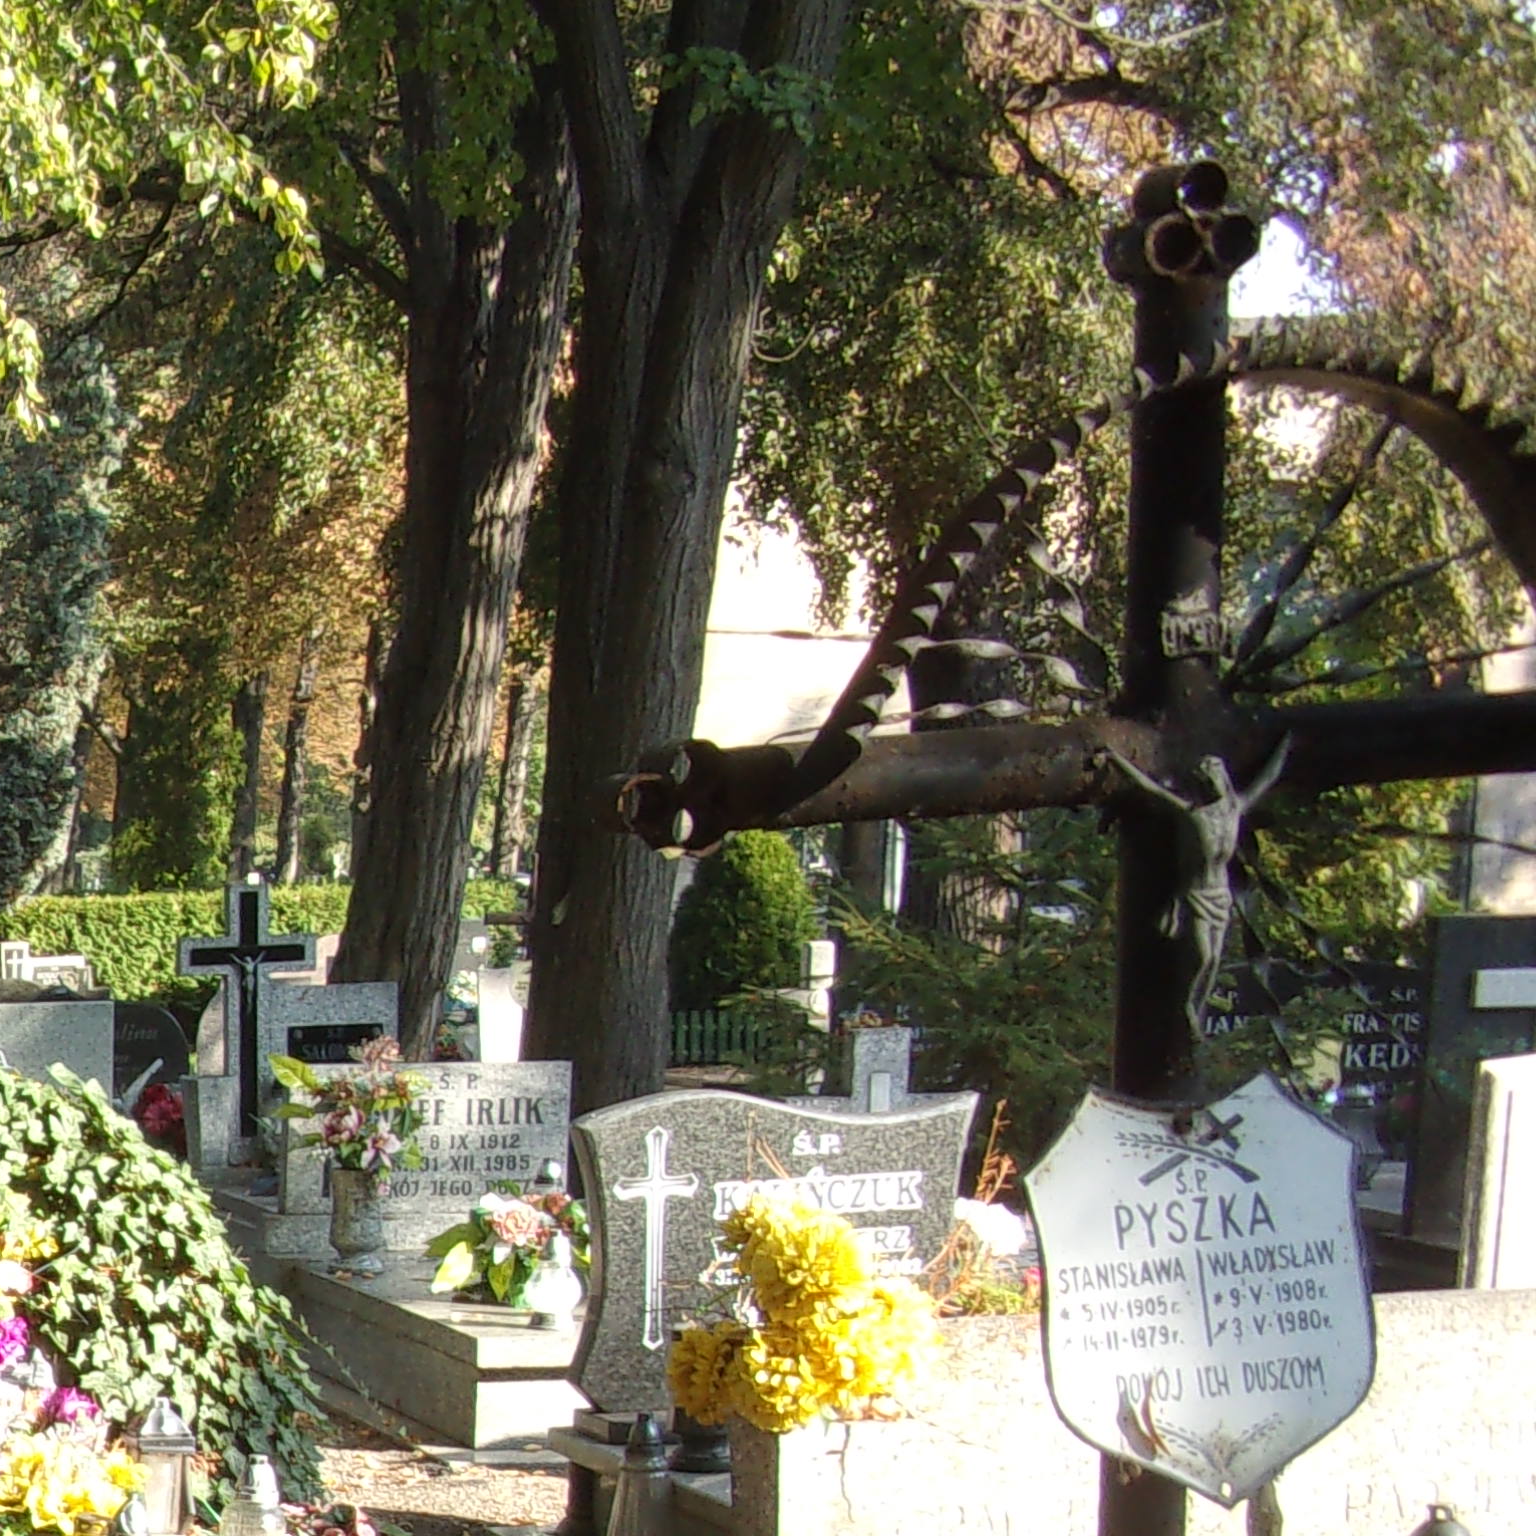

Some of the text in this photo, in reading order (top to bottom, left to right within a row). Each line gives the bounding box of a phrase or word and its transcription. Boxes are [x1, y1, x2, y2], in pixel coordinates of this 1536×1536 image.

[467, 1096, 546, 1126] IRLIK
[479, 1132, 521, 1150] 1912
[485, 1152, 532, 1172] 1985
[1114, 1190, 1276, 1251] PYSZKA
[1206, 1239, 1336, 1277] WŁADYSŁAW
[1058, 1256, 1187, 1295] STANISŁAWA
[1195, 1364, 1230, 1398] ICH
